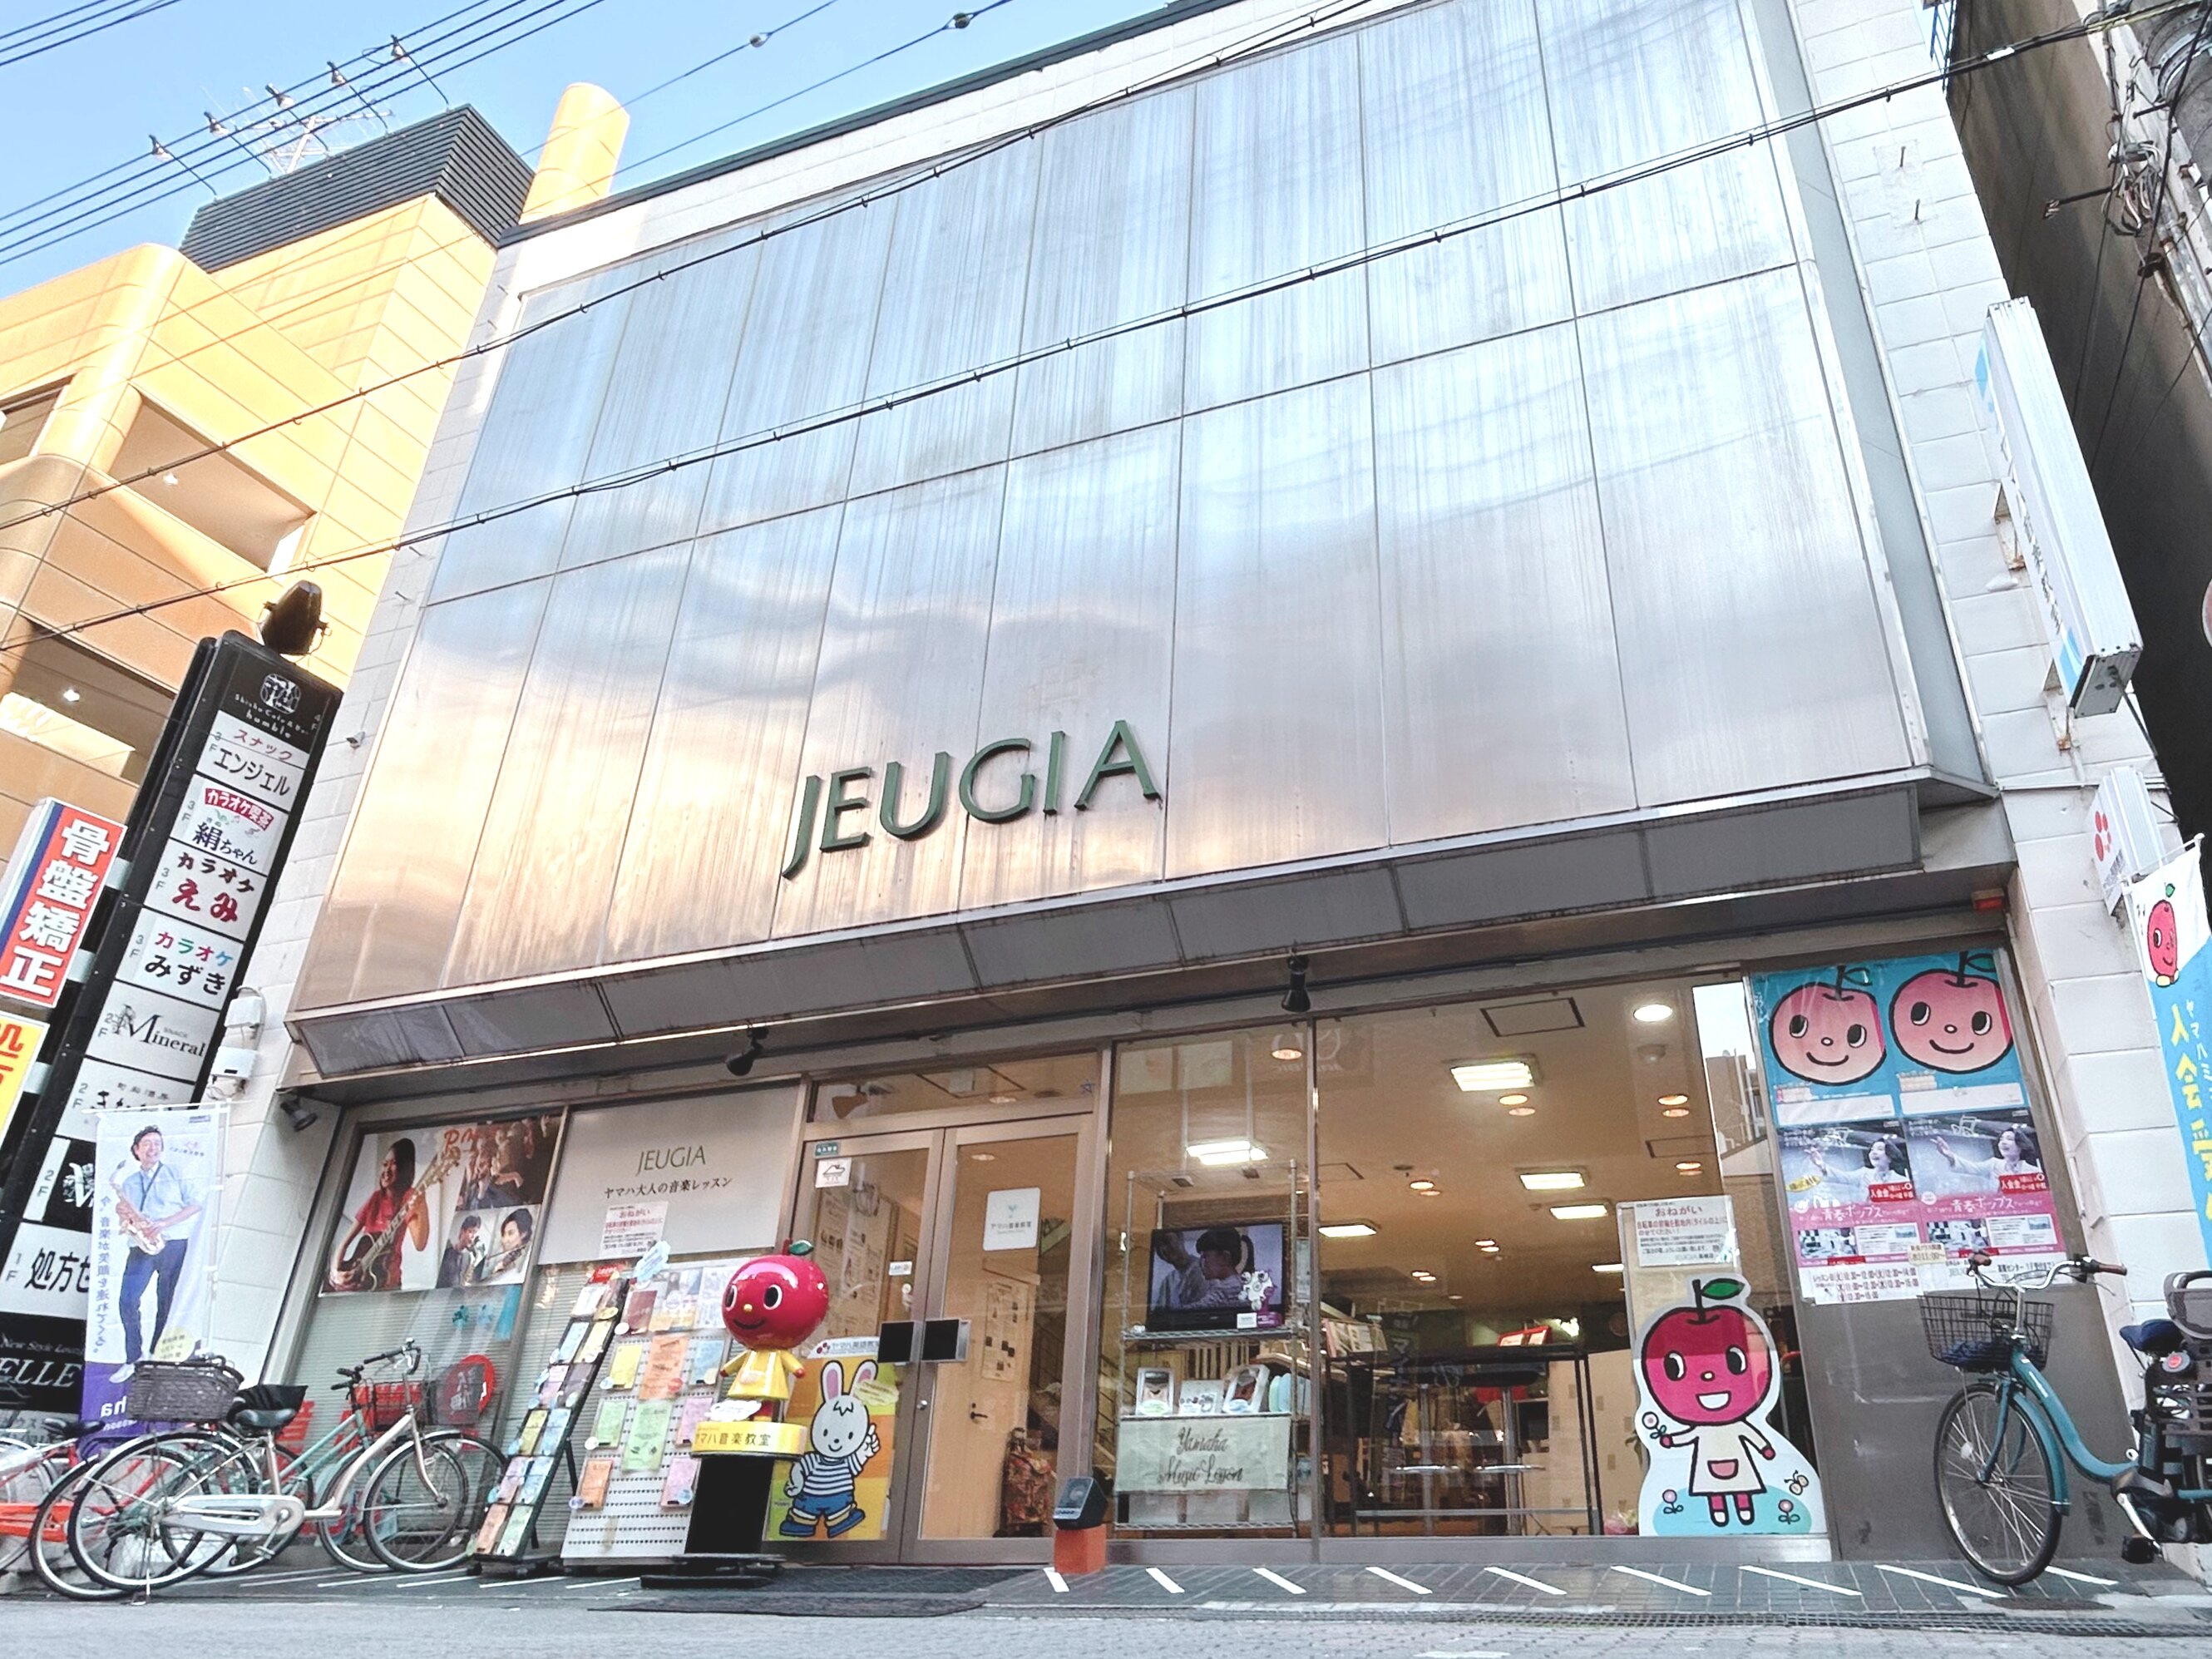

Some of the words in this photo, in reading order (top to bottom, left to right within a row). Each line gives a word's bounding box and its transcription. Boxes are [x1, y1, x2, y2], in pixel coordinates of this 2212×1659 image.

[245, 709, 291, 738] humble
[234, 728, 293, 761] スナック
[214, 748, 290, 796] エンジェル
[206, 788, 274, 830] カラオケ喫茶
[782, 720, 1162, 879] JEUGIA
[192, 822, 257, 865] 絹ちゃん
[177, 852, 254, 892] カラオケ
[0, 818, 110, 996] 骨盤矯正
[172, 878, 238, 922] えみ
[155, 931, 234, 967] カラオケ
[145, 955, 225, 995] みずき
[112, 1005, 206, 1057] Mineral
[635, 1145, 706, 1177] JEUGIA
[605, 1177, 733, 1198] ヤマハ大人の音楽レッスン
[1656, 1206, 1702, 1217] おねがい
